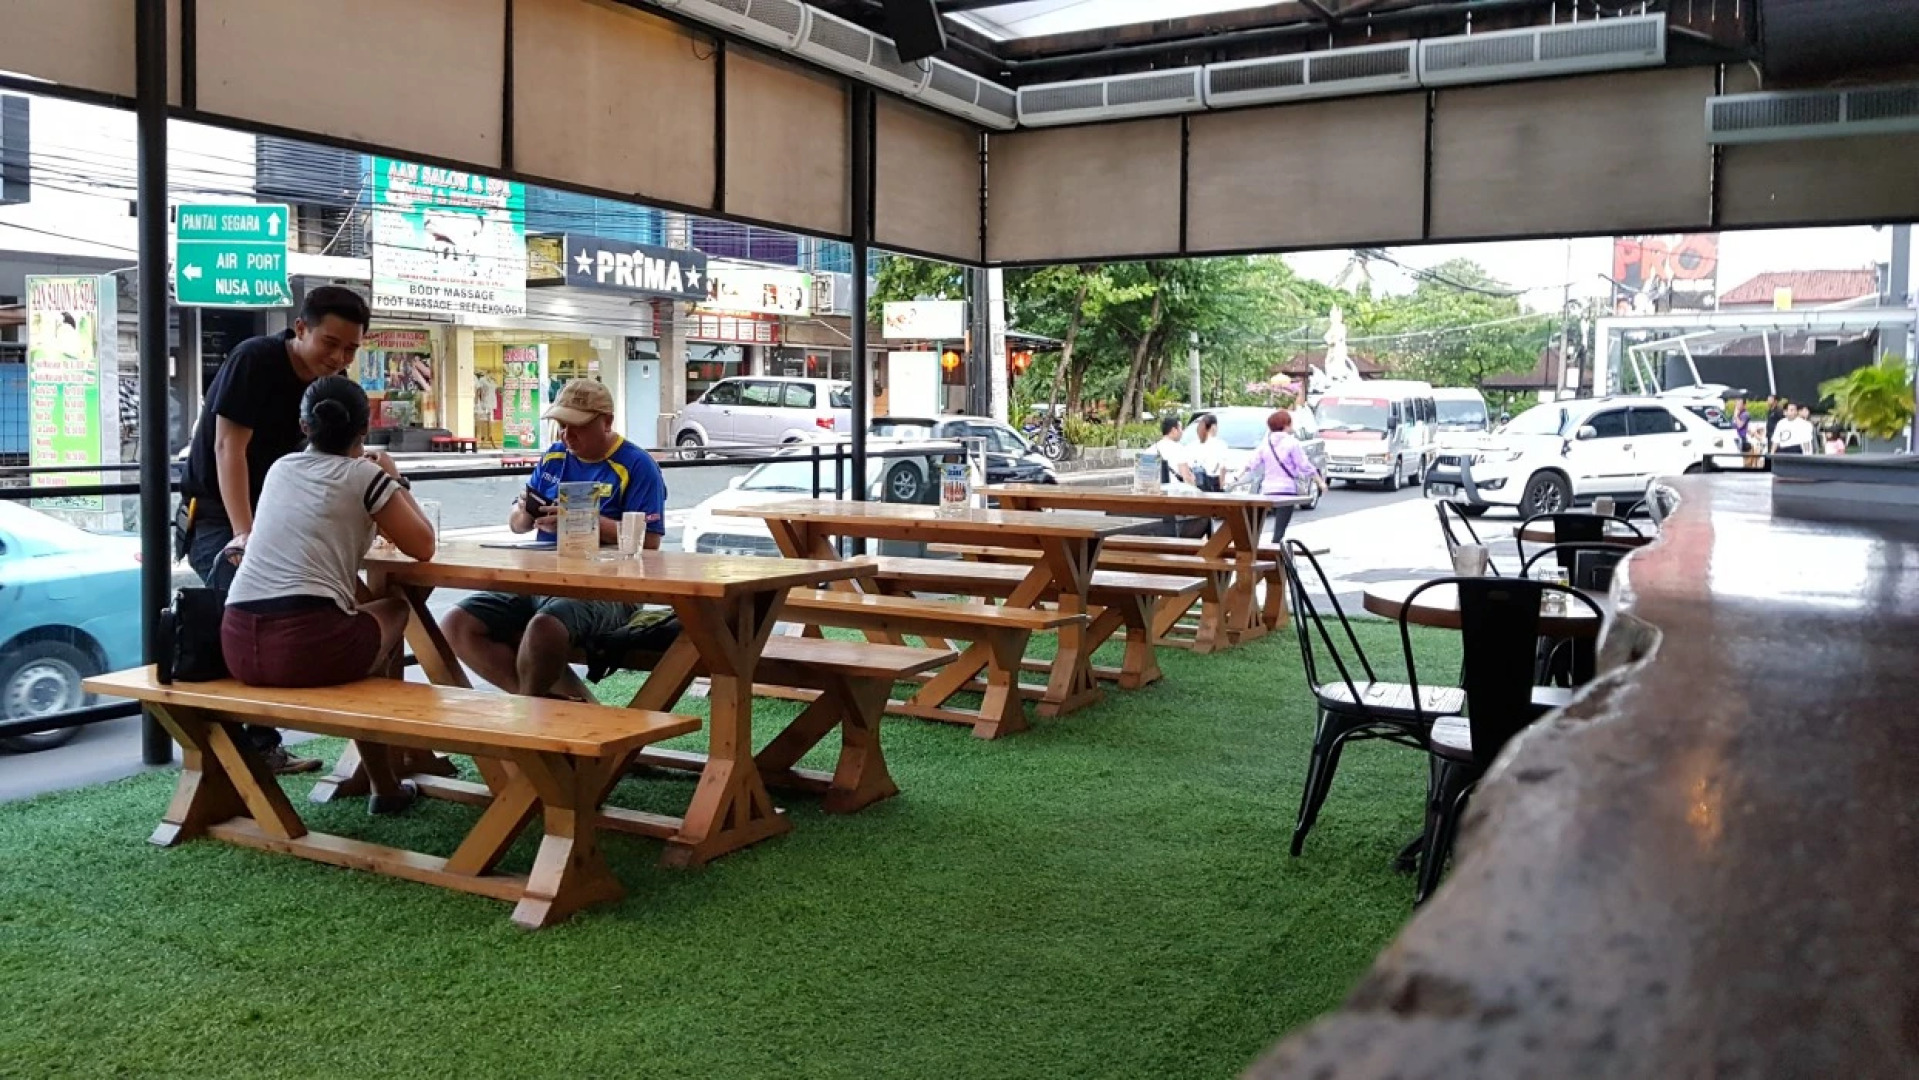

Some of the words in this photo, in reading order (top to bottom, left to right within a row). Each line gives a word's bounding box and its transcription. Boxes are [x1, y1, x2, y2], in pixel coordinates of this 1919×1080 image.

[421, 166, 469, 191] SALON
[486, 176, 511, 198] SPA
[182, 213, 217, 231] PANTAI
[221, 214, 260, 232] SEGARA
[216, 252, 238, 269] AIR
[246, 252, 281, 271] PORT
[1614, 235, 1716, 281] PRO
[215, 278, 250, 296] NUSA
[255, 280, 283, 297] DUA
[409, 284, 440, 295] BODY
[443, 286, 495, 301] MASSAGE
[377, 296, 403, 307] FOOT
